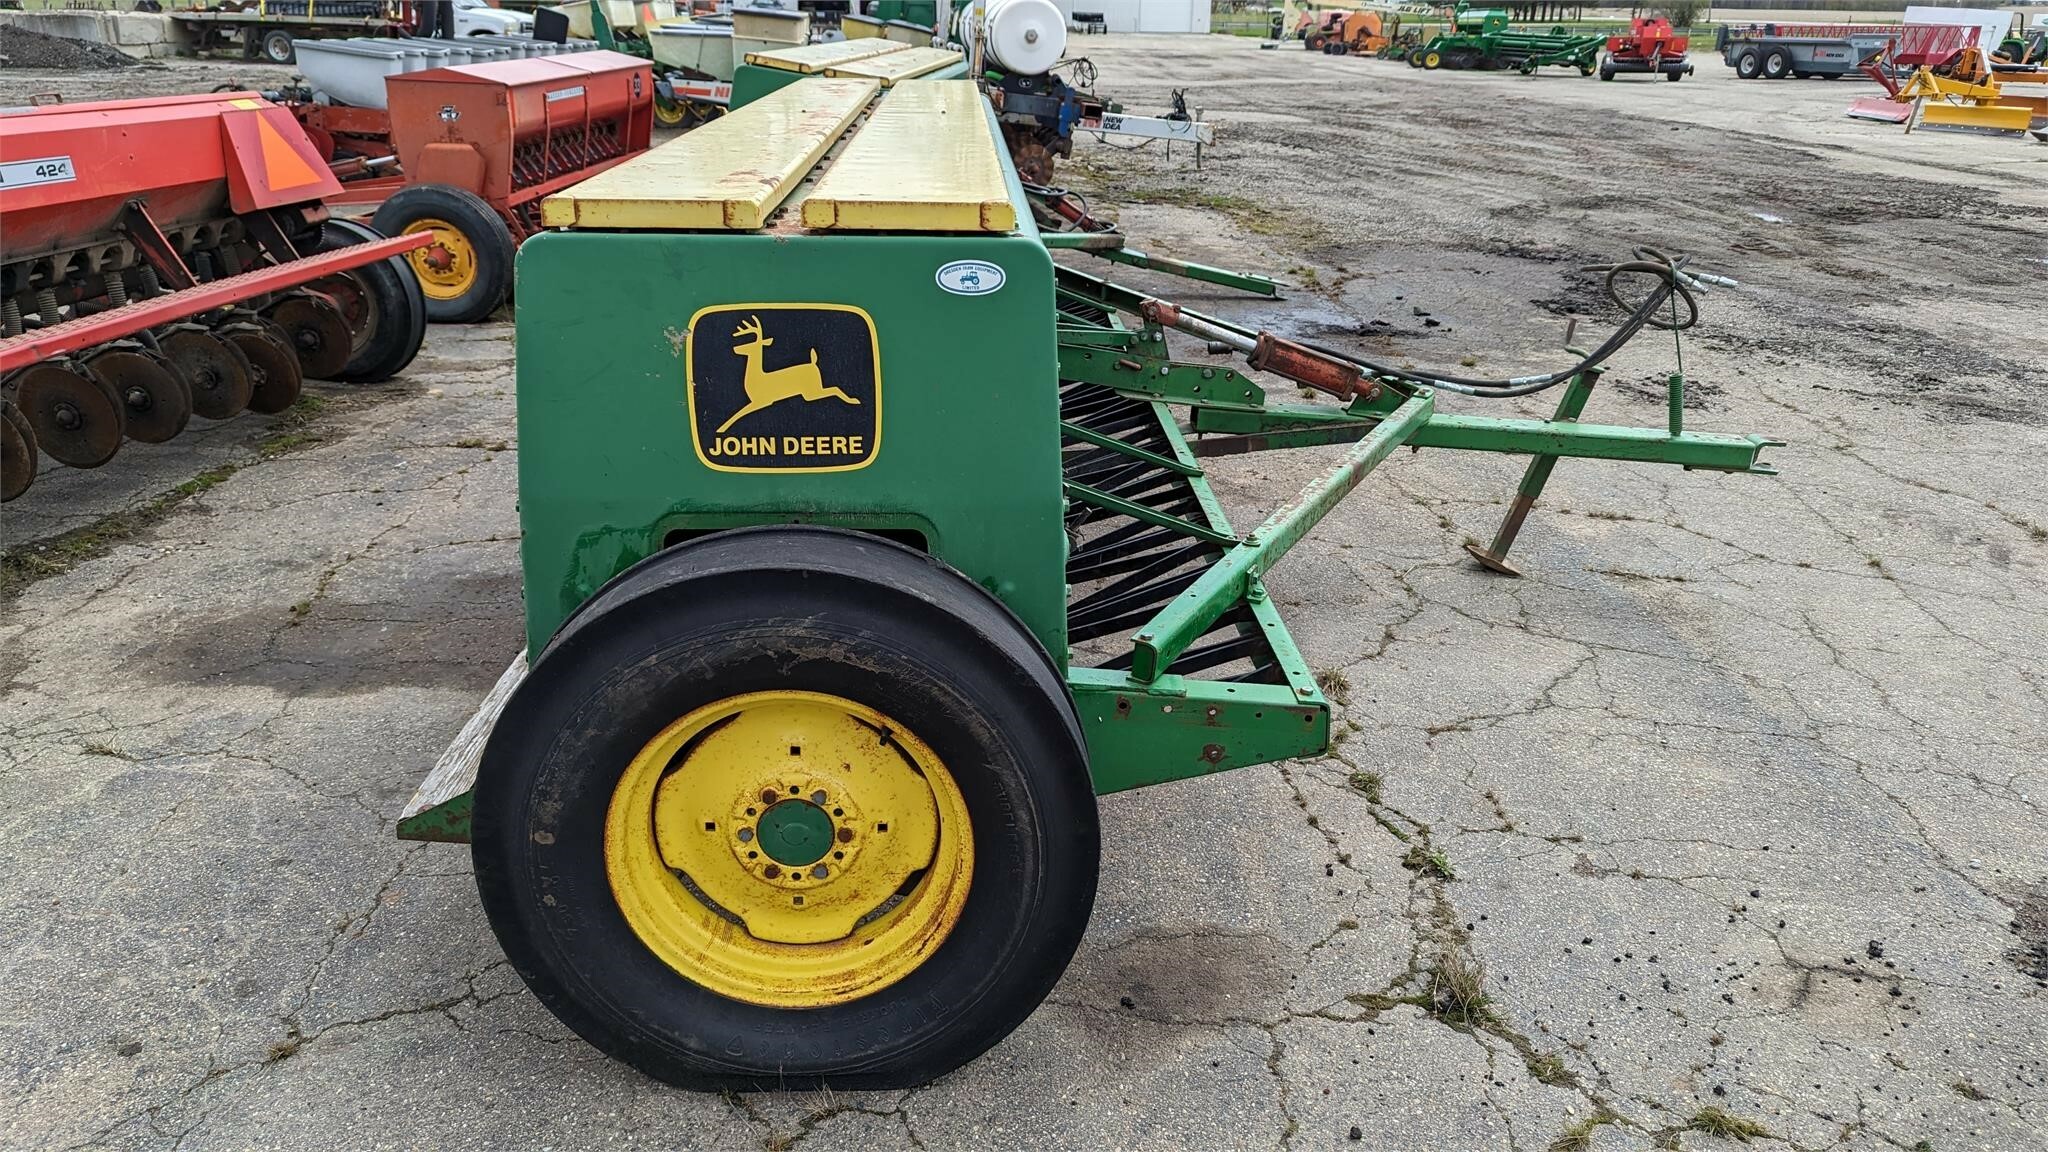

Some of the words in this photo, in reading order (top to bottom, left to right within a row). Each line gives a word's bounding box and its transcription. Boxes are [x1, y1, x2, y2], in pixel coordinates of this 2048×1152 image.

[1104, 116, 1124, 124] NEW
[36, 163, 69, 177] 424
[708, 436, 777, 456] JOHN
[783, 435, 864, 455] DEERE
